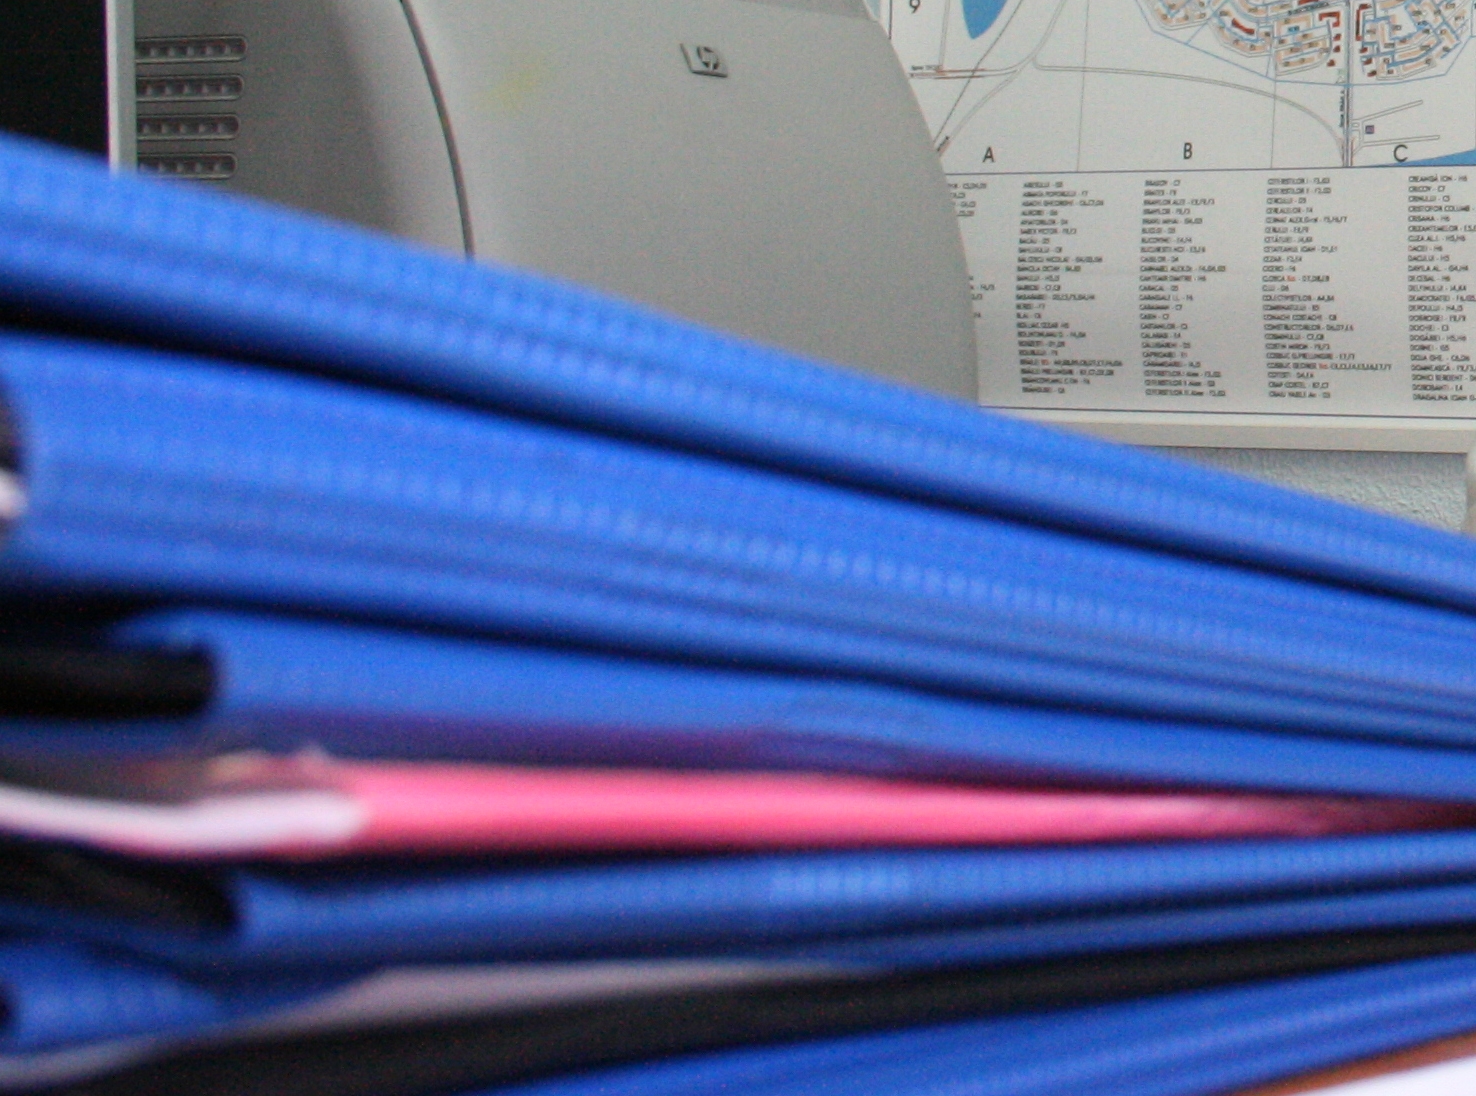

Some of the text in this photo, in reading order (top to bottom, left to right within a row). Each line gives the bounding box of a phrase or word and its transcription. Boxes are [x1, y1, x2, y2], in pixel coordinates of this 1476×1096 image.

[982, 147, 996, 163] A
[1183, 142, 1193, 160] B
[1393, 144, 1408, 163] C
